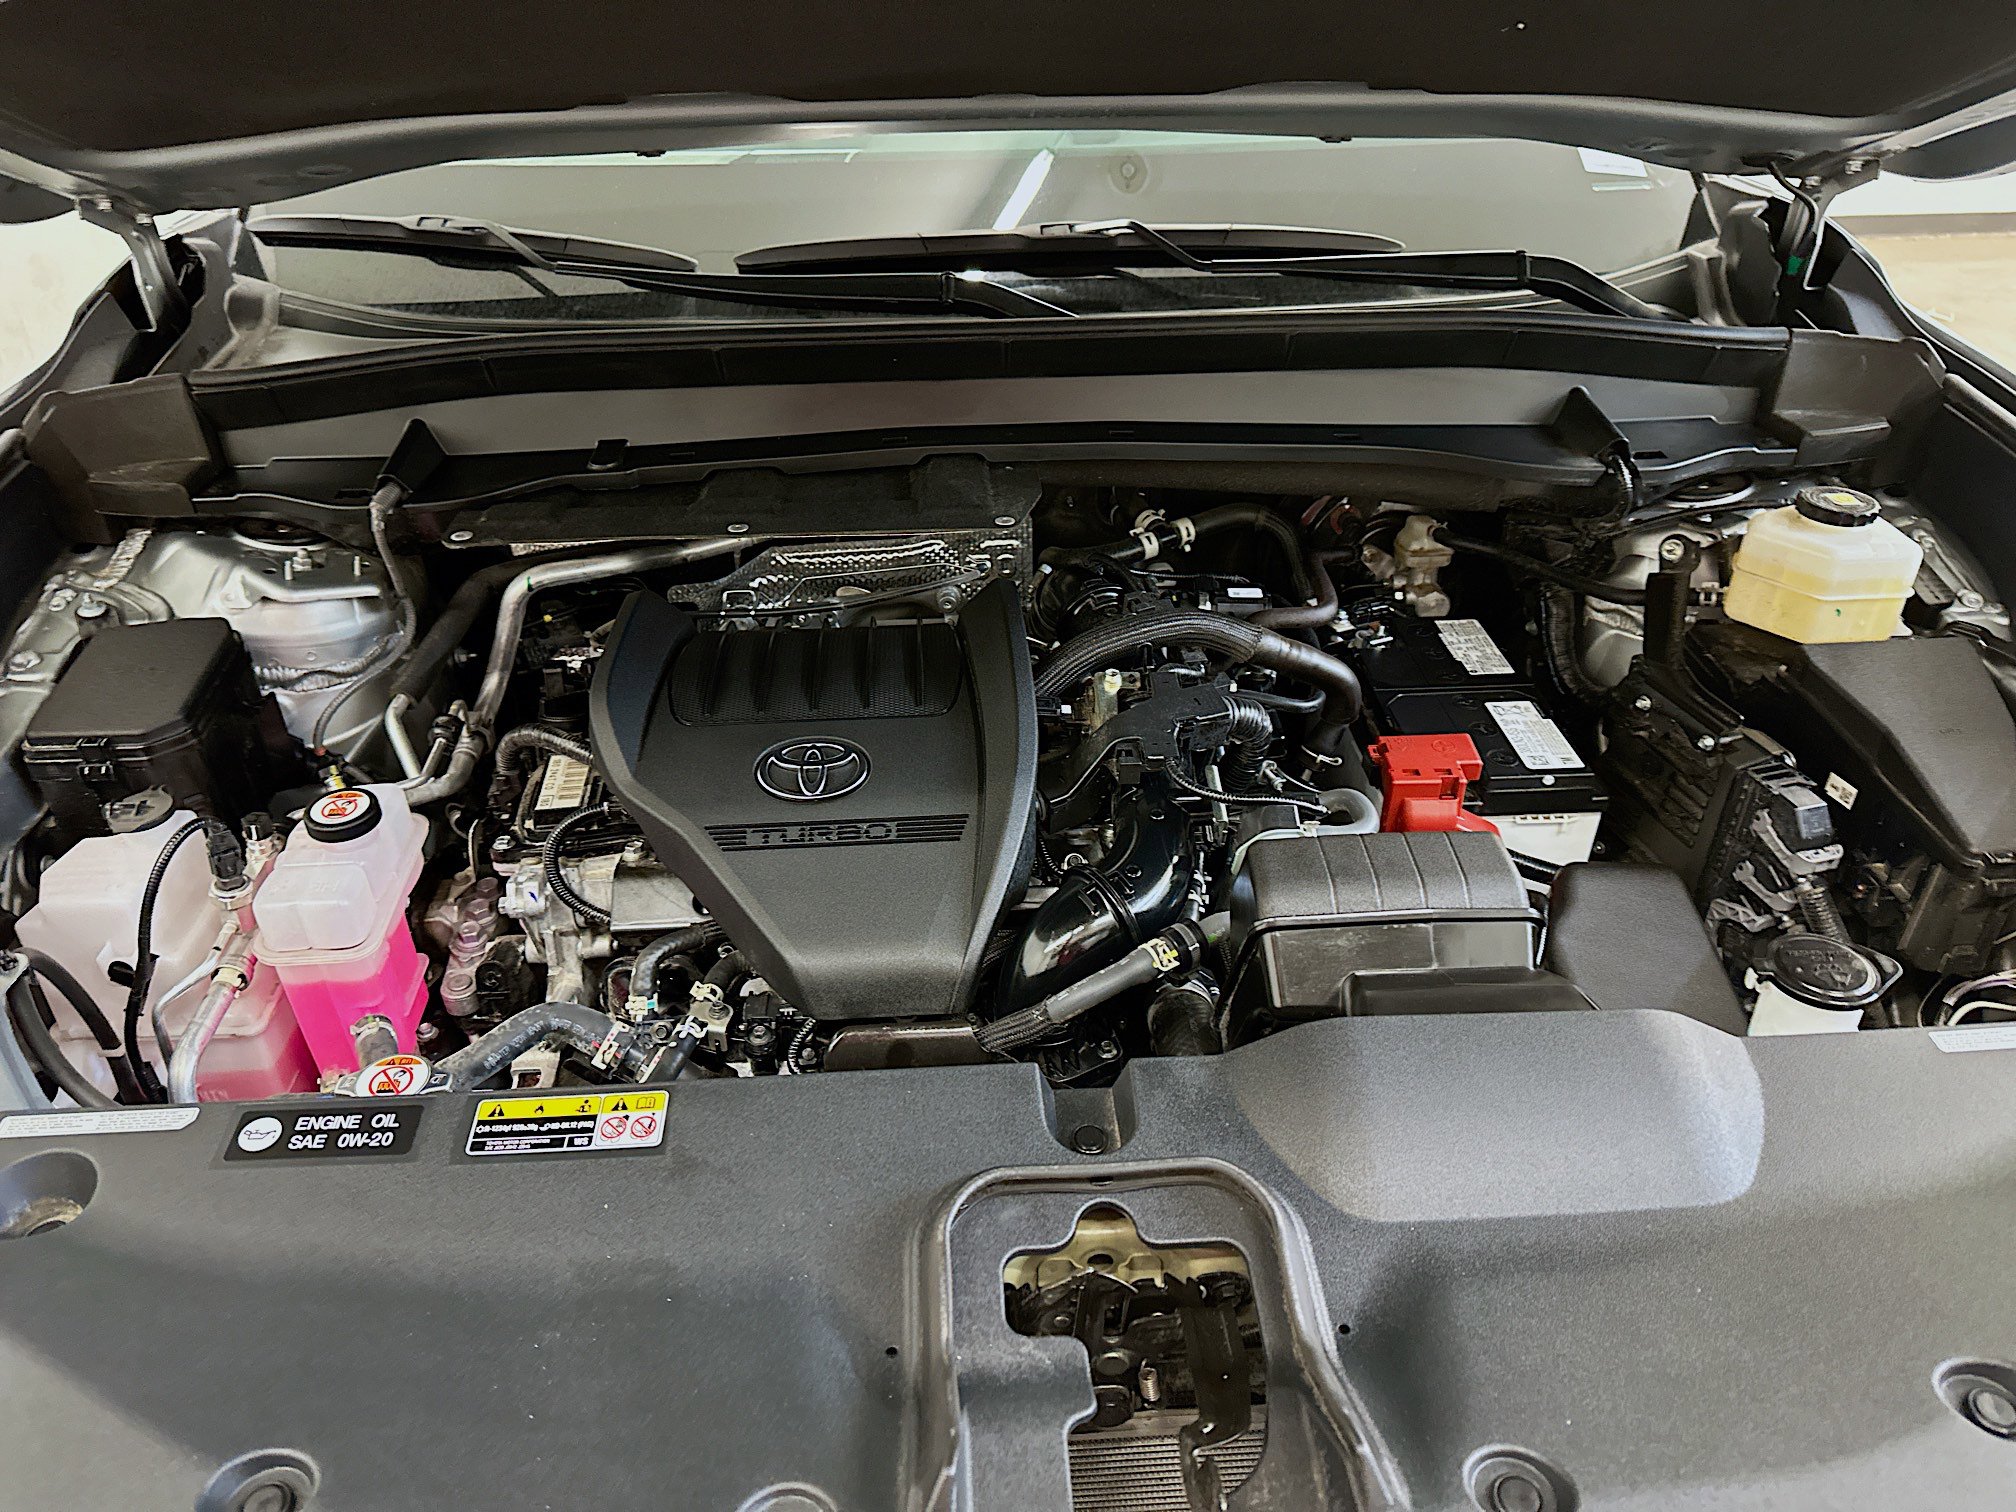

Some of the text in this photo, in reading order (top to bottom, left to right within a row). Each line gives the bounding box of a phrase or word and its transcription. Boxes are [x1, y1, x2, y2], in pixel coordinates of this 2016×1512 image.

[750, 823, 892, 844] TURBO
[294, 1113, 400, 1131] ENGINE OIL
[287, 1132, 394, 1150] SAE 0W-20
